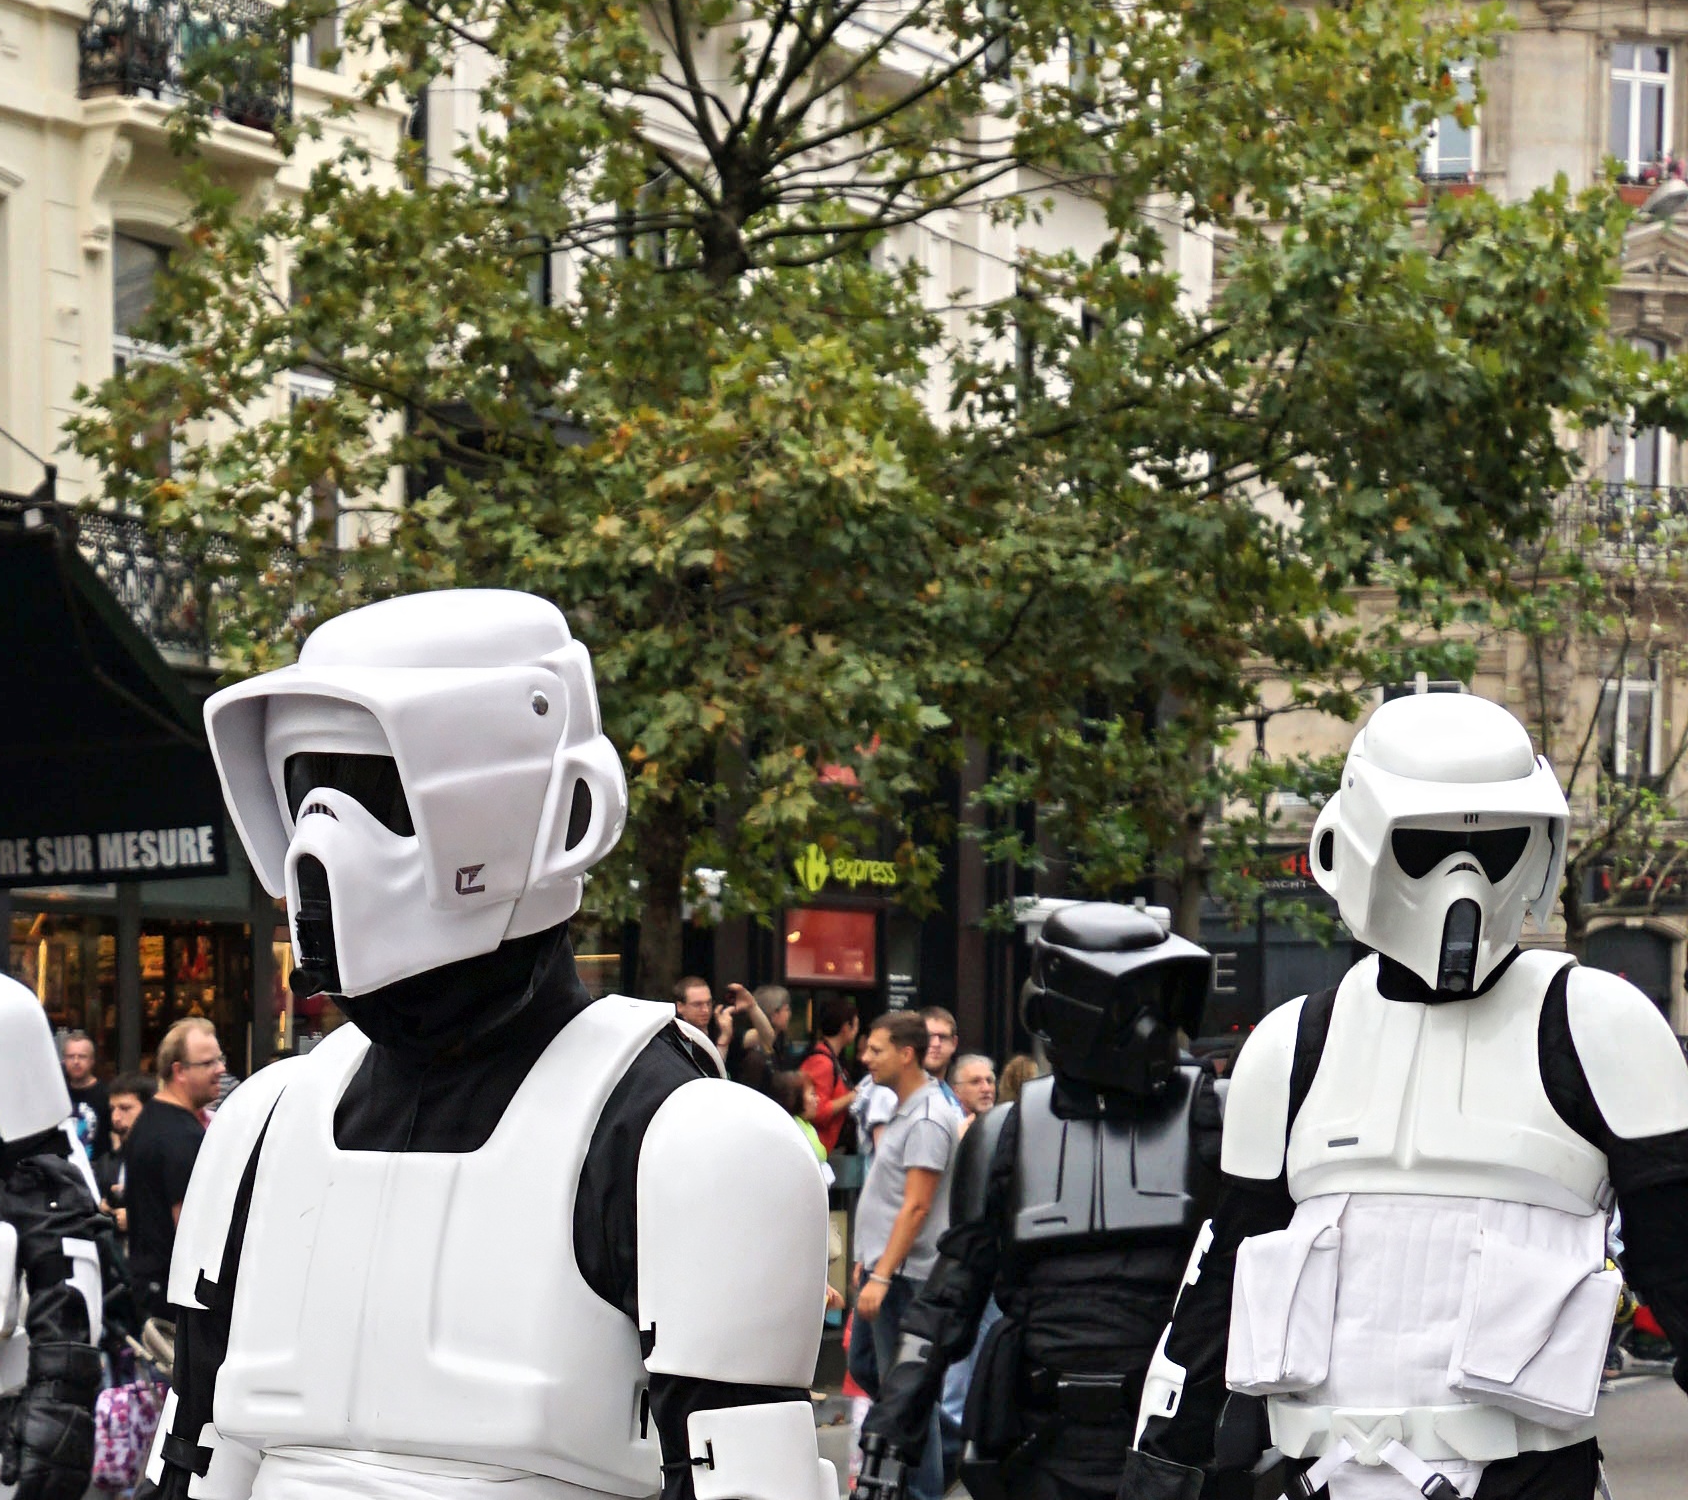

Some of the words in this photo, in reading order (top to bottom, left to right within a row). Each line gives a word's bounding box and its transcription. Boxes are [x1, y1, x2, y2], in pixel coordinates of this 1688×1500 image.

[35, 833, 94, 874] SUR
[97, 825, 216, 870] MESURE
[831, 857, 898, 888] express
